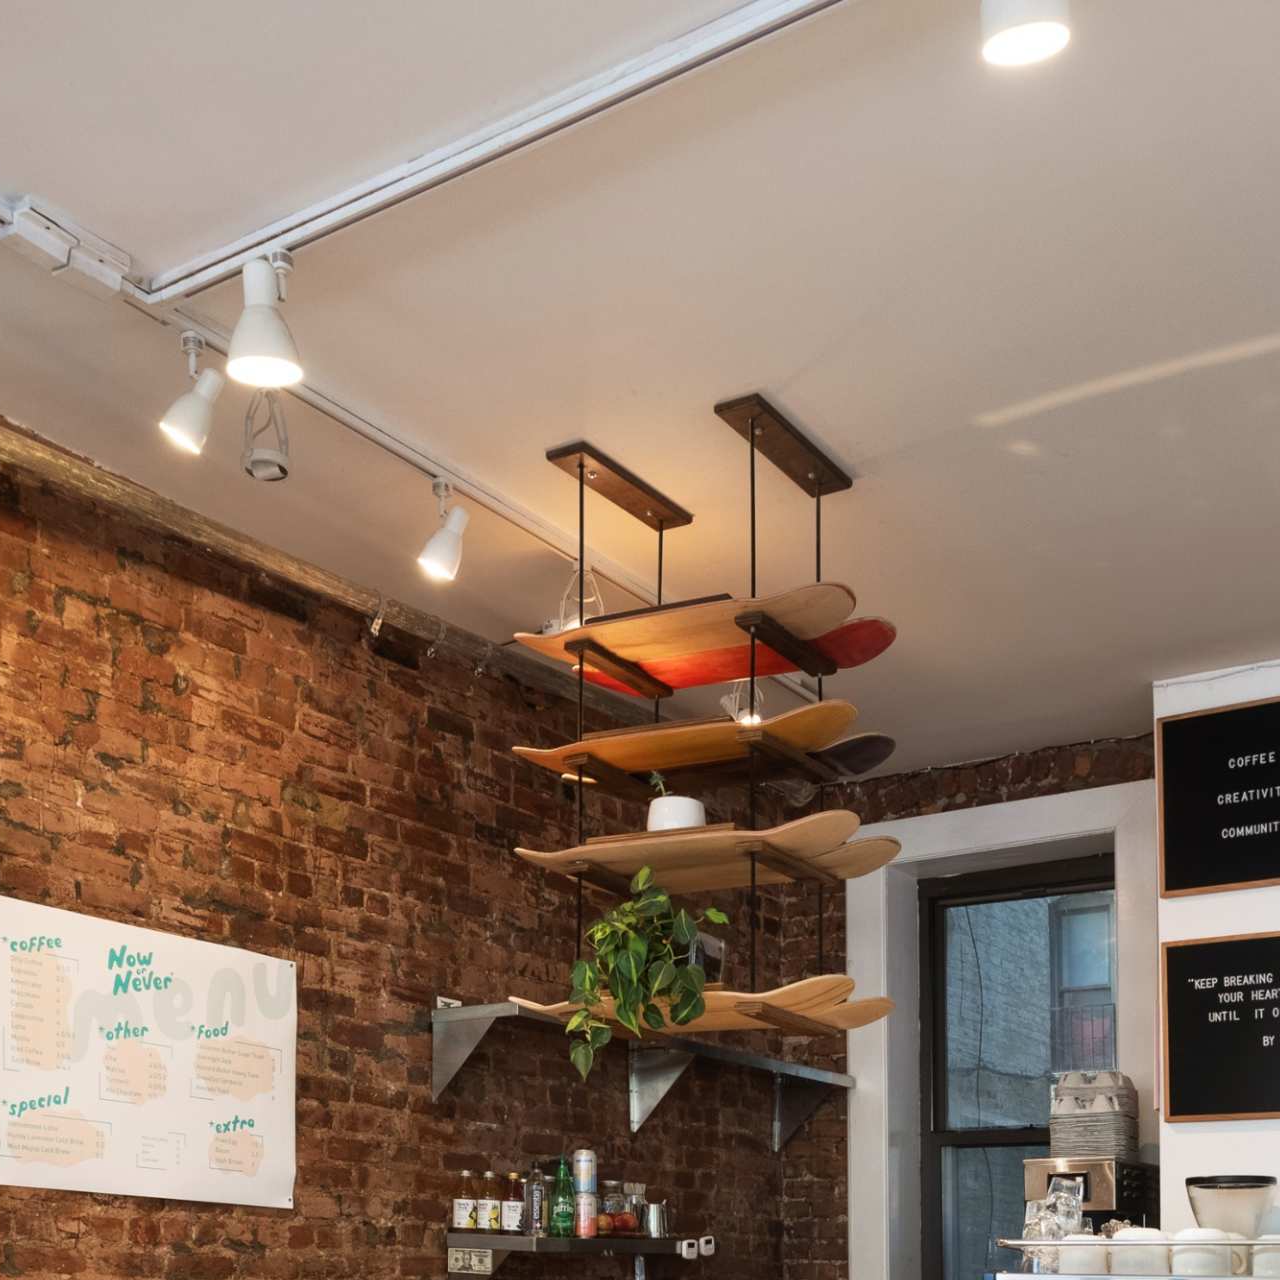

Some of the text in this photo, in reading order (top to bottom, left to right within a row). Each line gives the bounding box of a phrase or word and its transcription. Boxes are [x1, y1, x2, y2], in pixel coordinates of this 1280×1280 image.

[1228, 751, 1276, 769] COFFEE
[10, 935, 63, 953] coffee
[107, 944, 153, 970] Now
[136, 967, 146, 976] or
[1223, 972, 1274, 987] BREAKING
[112, 970, 173, 996] Never
[1218, 991, 1244, 1004] YOUR
[1208, 1010, 1240, 1023] UNTIL
[1254, 1008, 1265, 1020] IT
[105, 1020, 149, 1041] other
[196, 1021, 229, 1039] food
[1262, 1035, 1275, 1047] BY
[8, 1085, 70, 1118] special
[215, 1115, 255, 1134] extra
